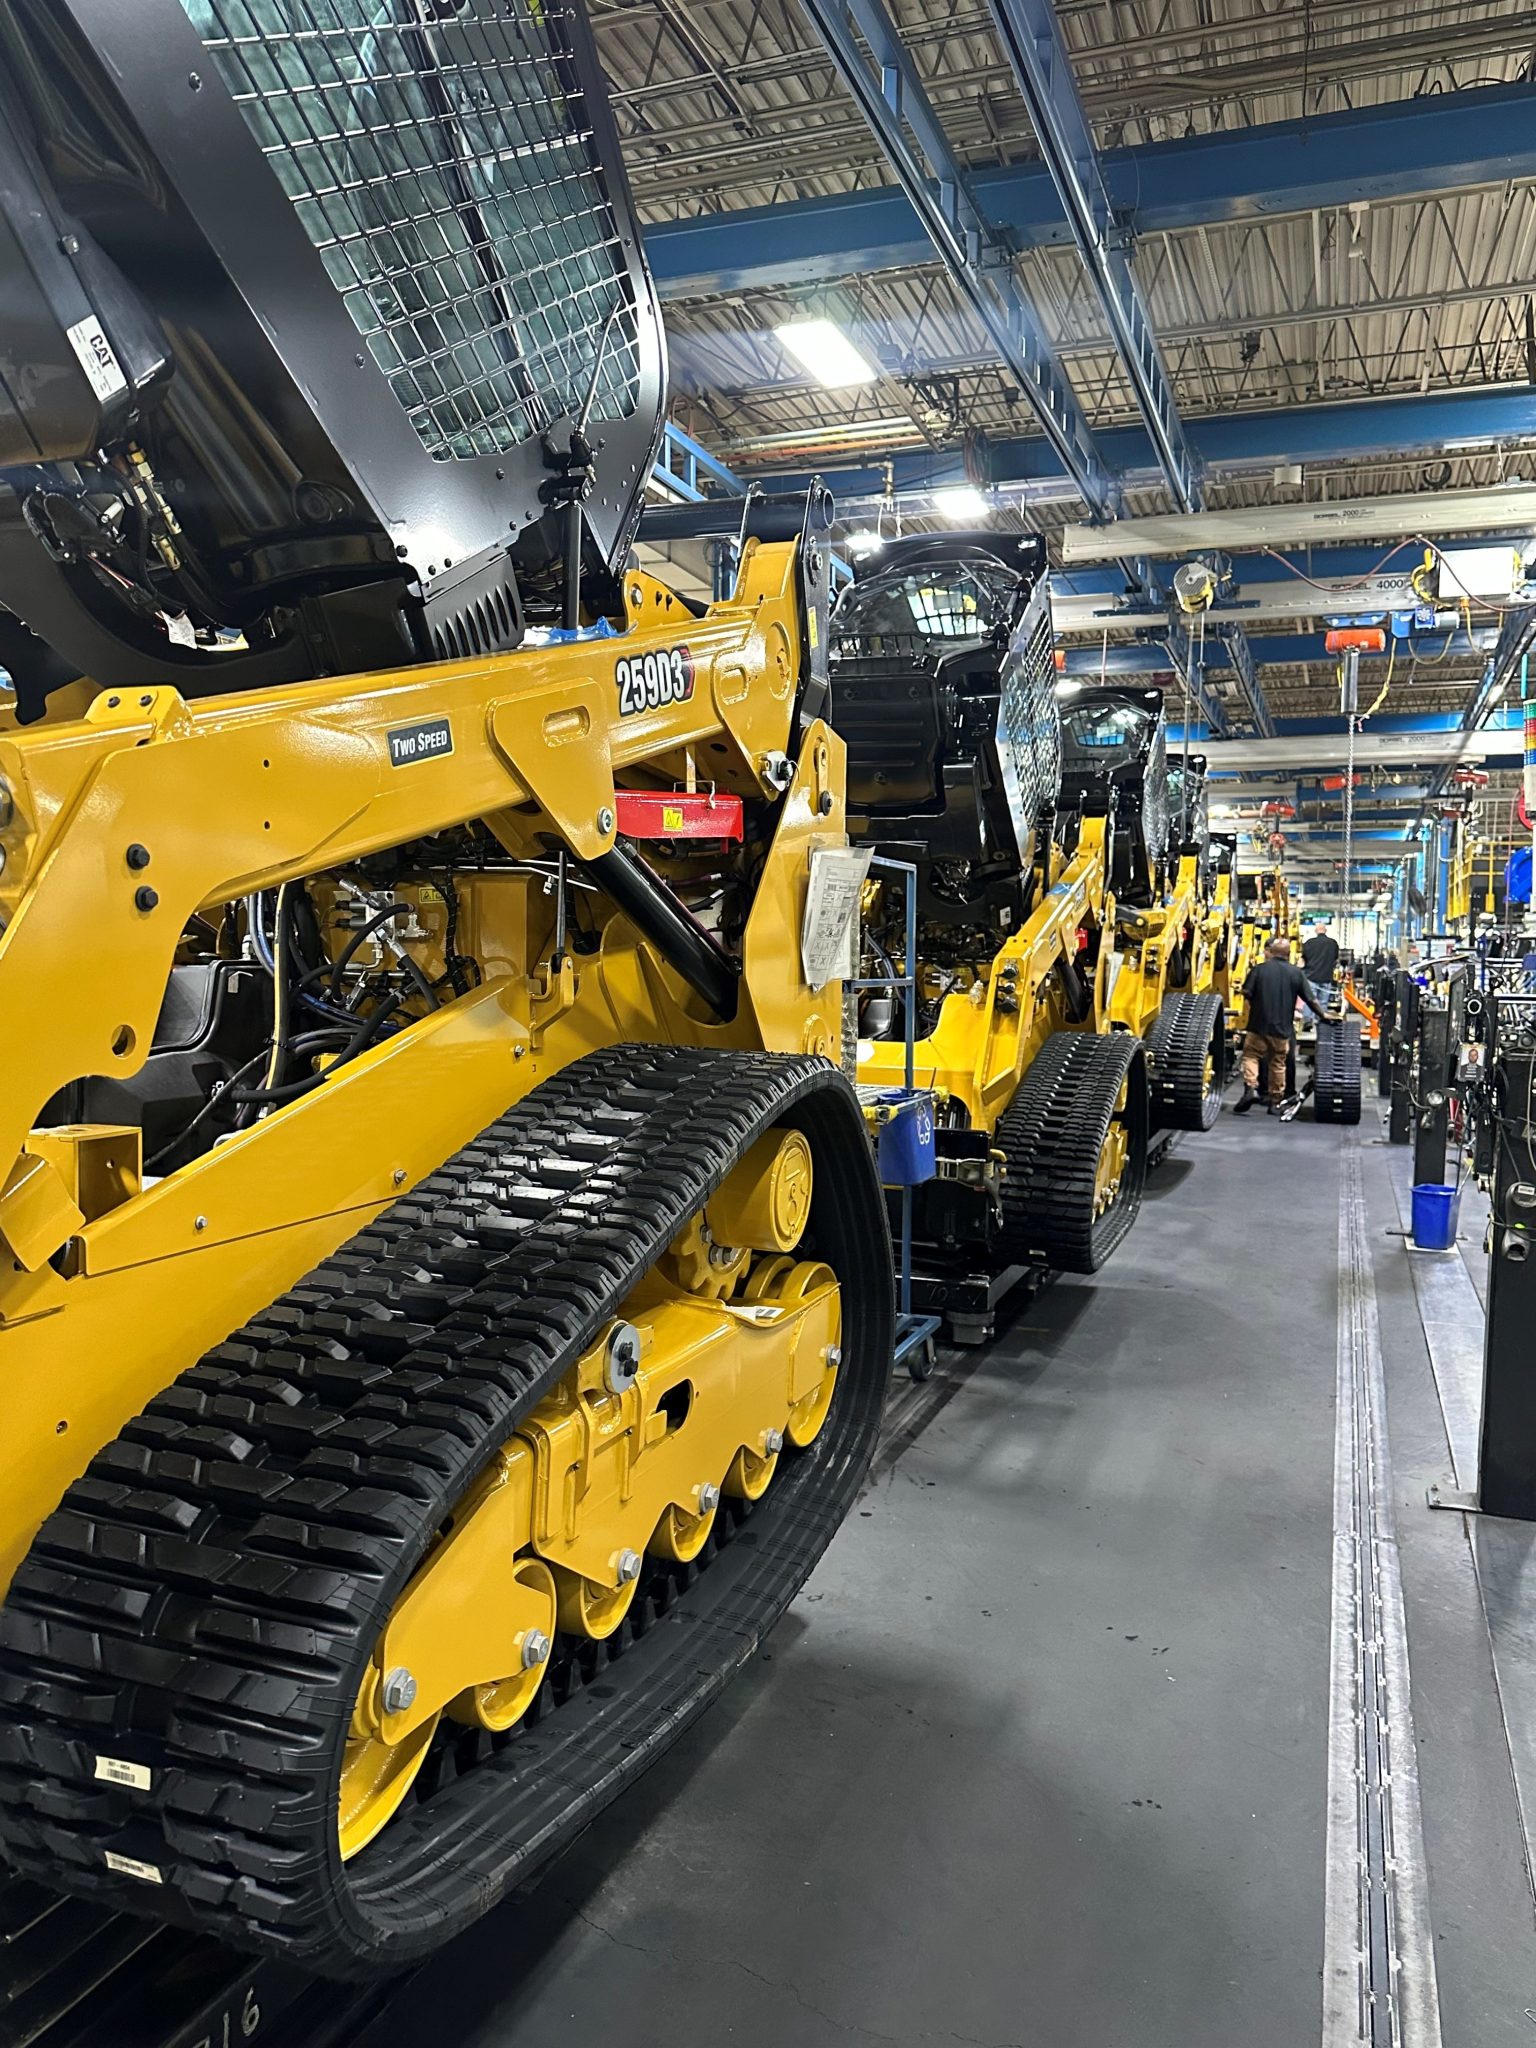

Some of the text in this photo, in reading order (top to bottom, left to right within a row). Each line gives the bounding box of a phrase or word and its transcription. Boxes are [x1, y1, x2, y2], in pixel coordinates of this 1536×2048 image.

[90, 335, 114, 368] CAT
[1343, 509, 1360, 517] 2000
[1376, 580, 1404, 589] 4000
[617, 650, 685, 713] 259D3
